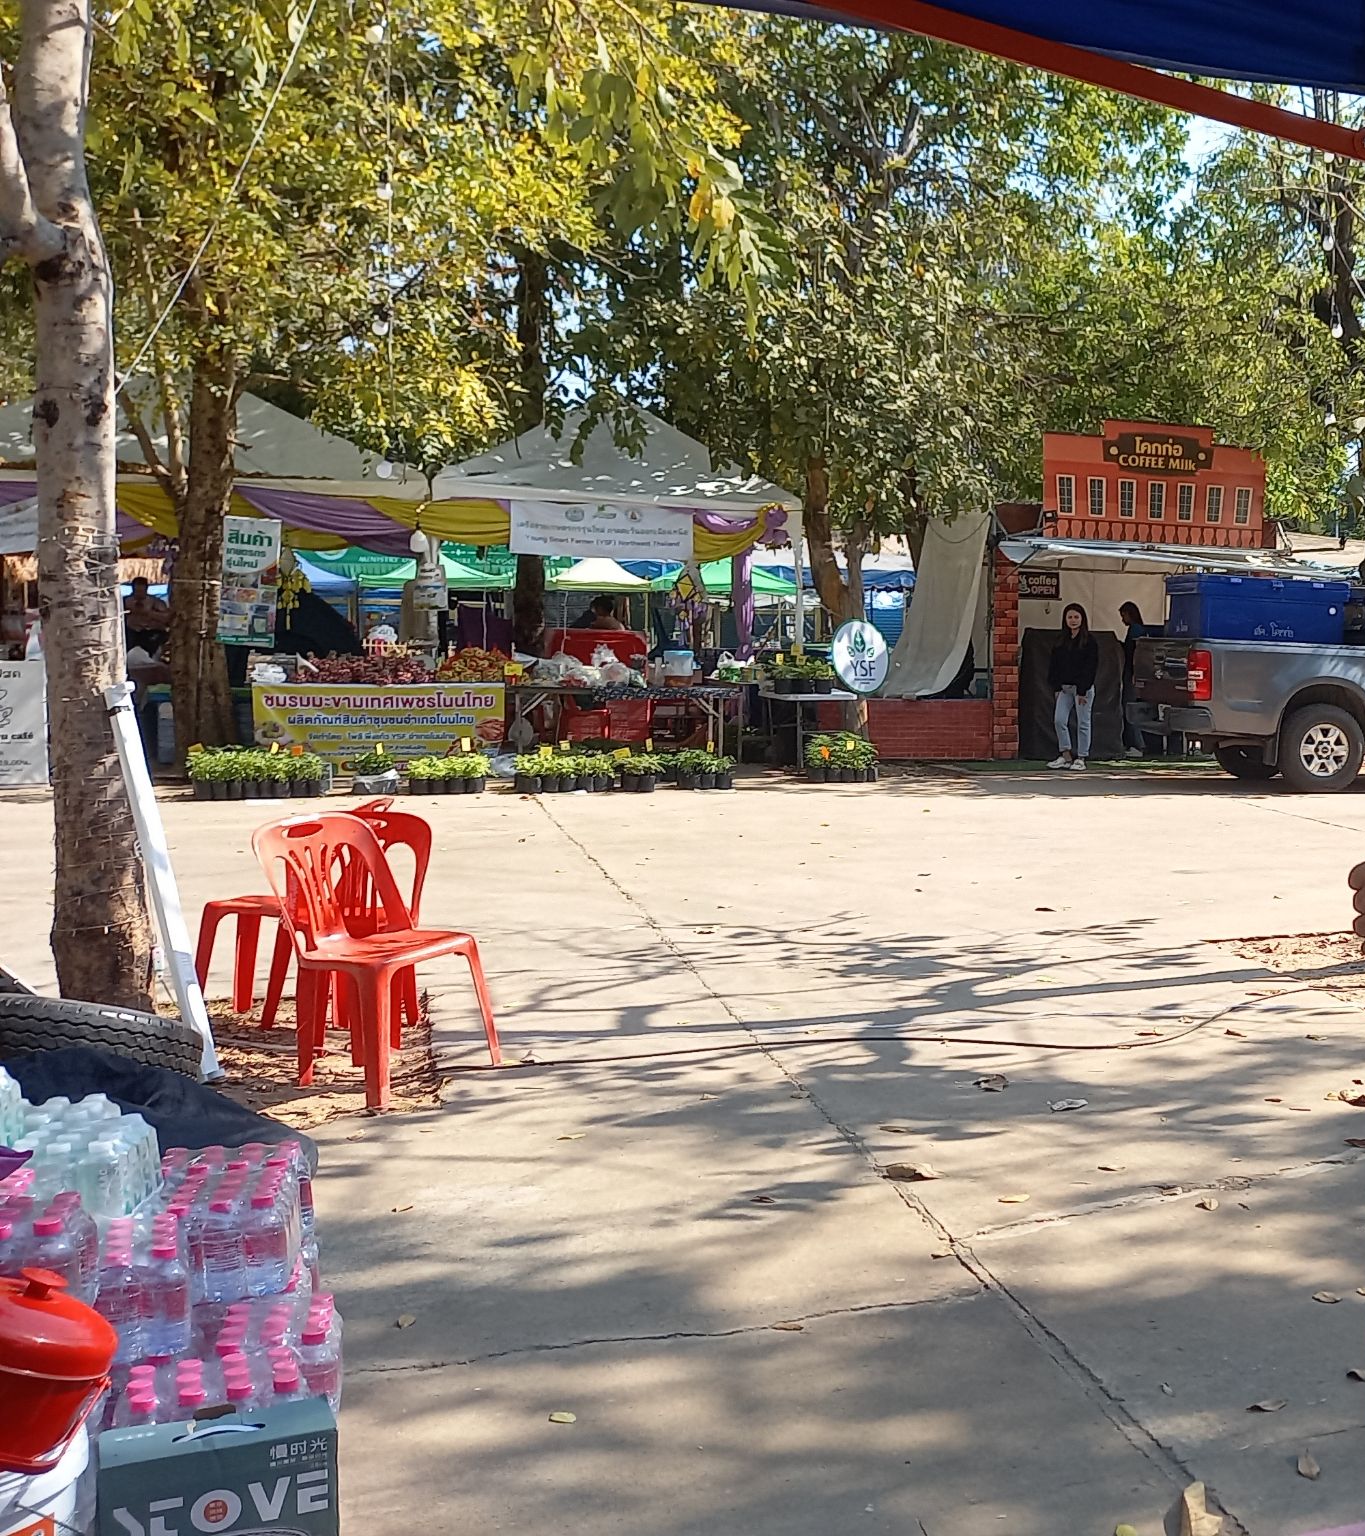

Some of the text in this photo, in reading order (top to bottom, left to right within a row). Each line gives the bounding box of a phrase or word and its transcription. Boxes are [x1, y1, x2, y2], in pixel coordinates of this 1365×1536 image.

[1135, 436, 1183, 457] โคกก่อ
[1119, 454, 1165, 469] COFFEE
[227, 528, 273, 547] สินค้า
[1028, 575, 1058, 586] coffee
[1030, 585, 1056, 595] OPEN
[850, 660, 876, 677] YSF
[264, 691, 495, 708] ชมรมมะขามเทศเพชรโนนไทย
